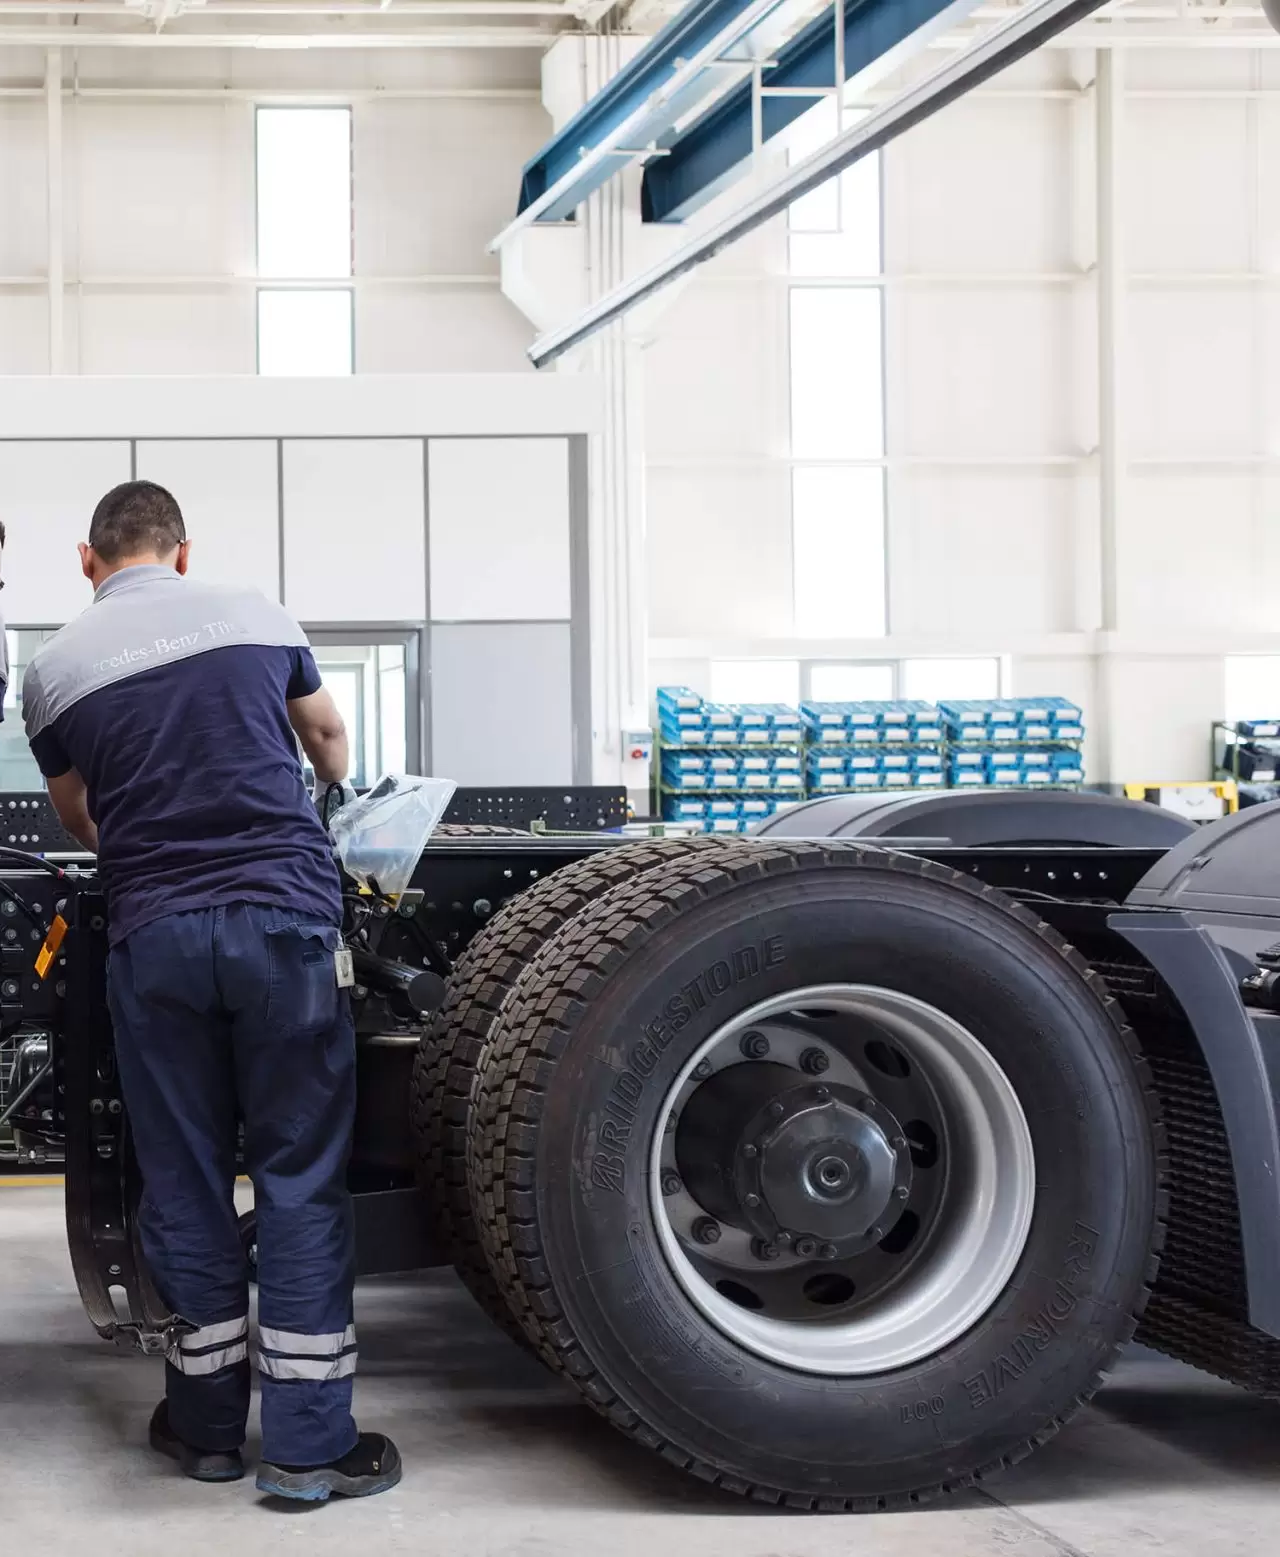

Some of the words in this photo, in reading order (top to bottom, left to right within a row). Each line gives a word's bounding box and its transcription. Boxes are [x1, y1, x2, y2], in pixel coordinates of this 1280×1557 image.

[92, 632, 200, 673] rcedes-Benz
[204, 620, 235, 640] Tü
[591, 934, 788, 1196] BRIDGESTONE
[900, 1393, 946, 1424] 001
